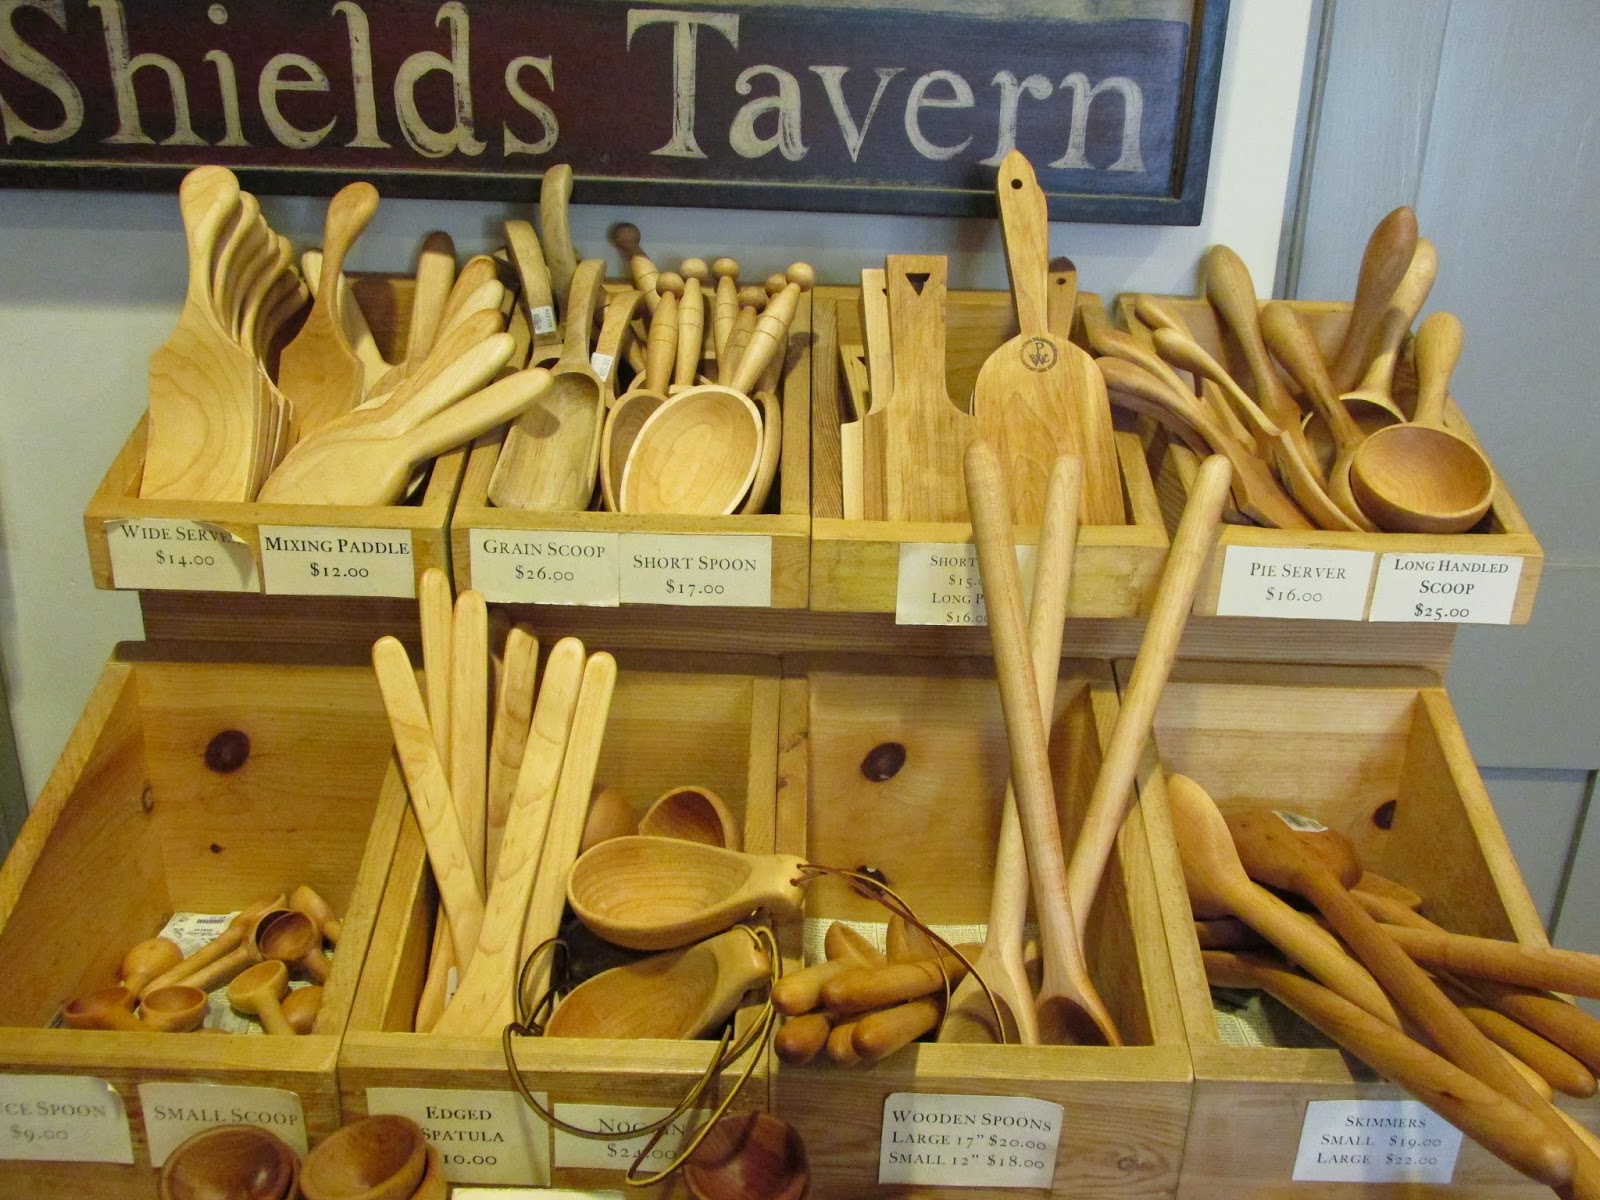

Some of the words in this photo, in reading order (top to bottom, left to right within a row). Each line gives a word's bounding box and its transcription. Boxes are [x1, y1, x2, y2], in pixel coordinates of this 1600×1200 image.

[0, 0, 559, 158] Shields
[626, 8, 1147, 173] Tavern
[120, 524, 171, 541] WIDE
[176, 526, 246, 545] SERVE
[265, 536, 332, 553] MIXING
[337, 538, 410, 555] PADDLE
[483, 539, 542, 556] GRAIN
[547, 542, 606, 558] SCOOP
[156, 550, 215, 568] $14.00
[633, 555, 694, 570] SHORT
[698, 556, 757, 571] SPOON
[930, 555, 977, 567] SHORT
[1394, 558, 1435, 571] LONG
[1438, 560, 1509, 574] HANDLED
[310, 562, 369, 578] $12.00
[515, 565, 575, 582] $26.00
[1250, 562, 1277, 577] PIE
[1281, 563, 1347, 580] SERVER
[666, 579, 725, 596] $17.00
[949, 574, 983, 589] $15.
[1419, 580, 1475, 595] SCOOP
[932, 593, 971, 604] LONG
[1266, 586, 1323, 603] $16.00
[1414, 603, 1470, 620] $25.00
[36, 1102, 106, 1118] SPOON
[154, 1105, 226, 1123] SMALL
[231, 1107, 298, 1126] SCOOP
[426, 1106, 492, 1121] EDGED
[893, 1110, 976, 1126] WOODEN
[981, 1112, 1052, 1133] SPOONS
[1344, 1115, 1427, 1128] SKIMMERS
[10, 1124, 68, 1142] $9.00
[421, 1127, 504, 1143] SPATULA
[892, 1131, 951, 1145] LARGE
[989, 1134, 1047, 1151] $20.00
[1320, 1133, 1375, 1147] SMALL
[1388, 1135, 1442, 1149] $19.00
[443, 1154, 498, 1166] 10.00
[888, 1151, 946, 1165] SMALL
[987, 1154, 1045, 1169] $18.00
[1316, 1152, 1372, 1165] LARGE
[1385, 1153, 1439, 1166] $22.00
